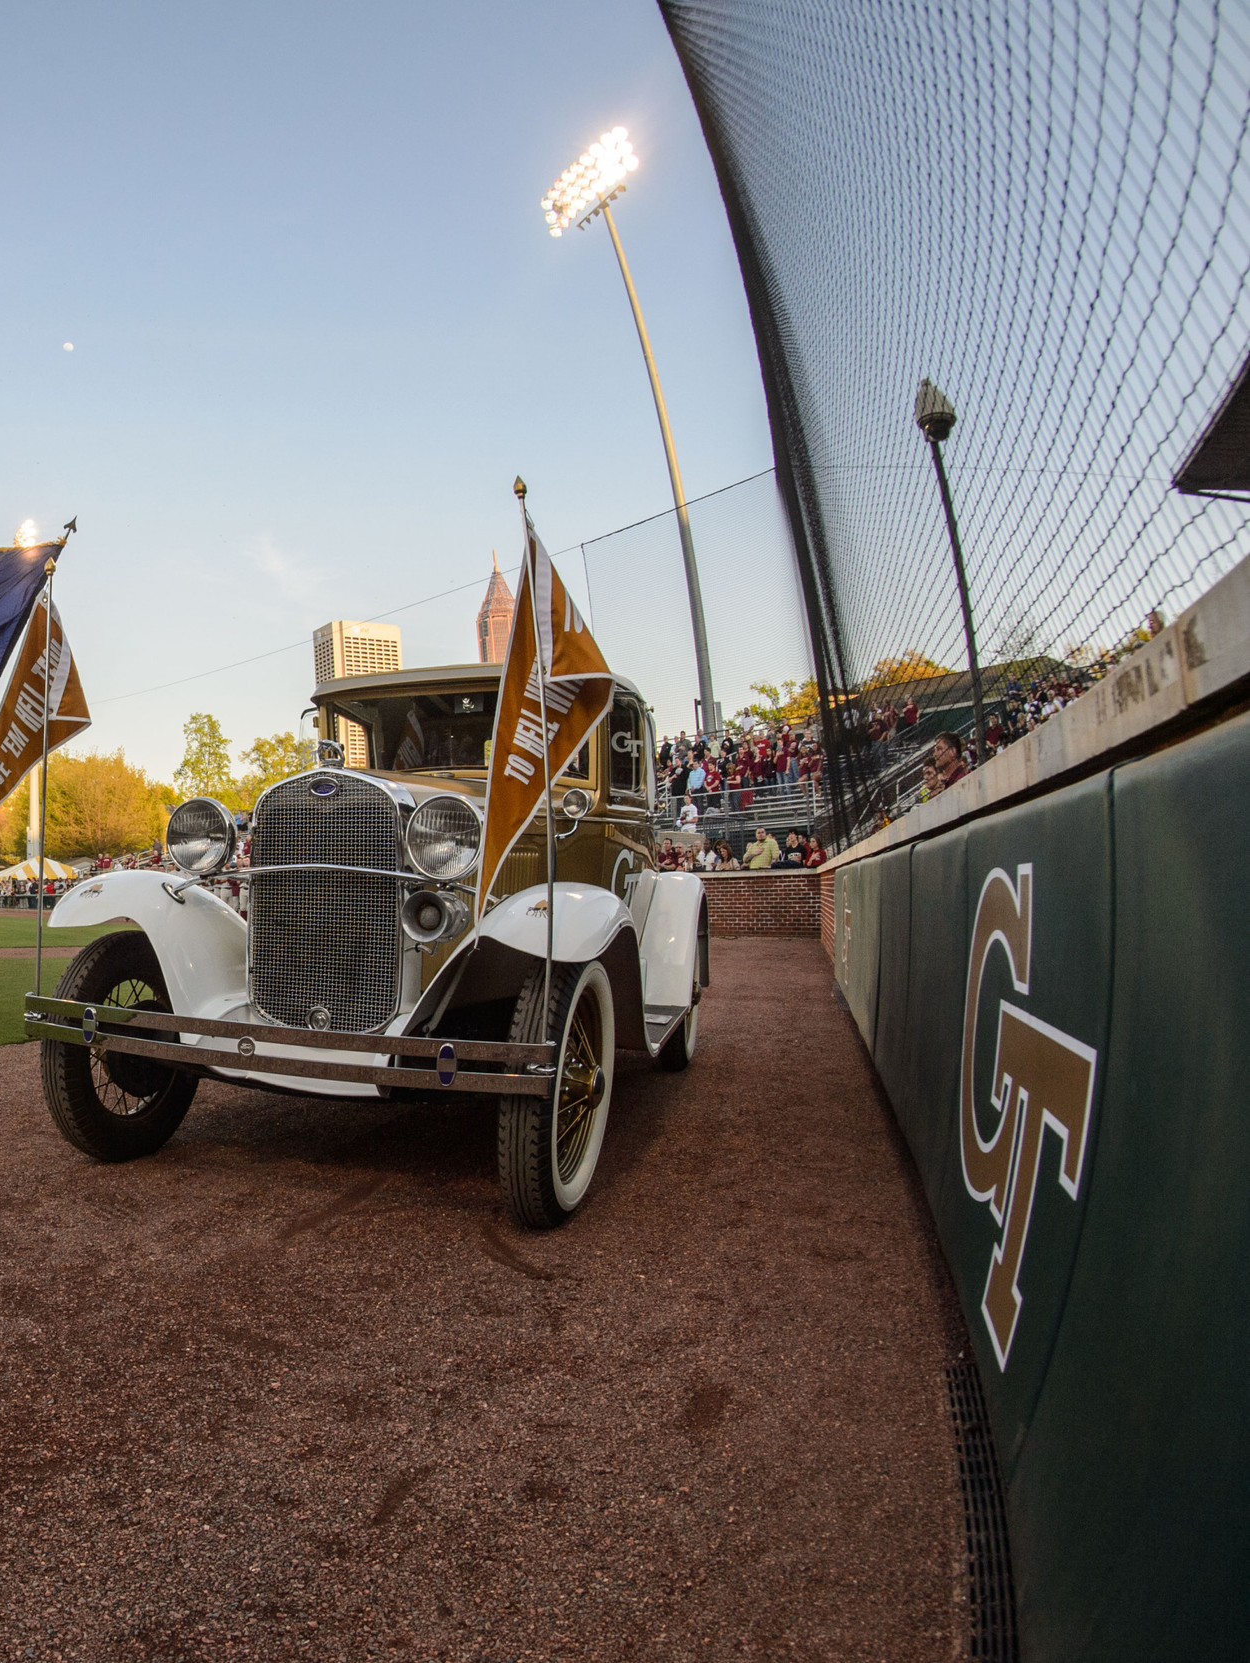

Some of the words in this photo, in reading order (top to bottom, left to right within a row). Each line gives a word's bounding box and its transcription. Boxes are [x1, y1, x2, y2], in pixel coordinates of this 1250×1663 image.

[0, 721, 30, 759] 'EM
[513, 708, 560, 759] HELL
[611, 731, 643, 757] GT
[504, 754, 535, 785] TO
[959, 862, 1098, 1373] GT
